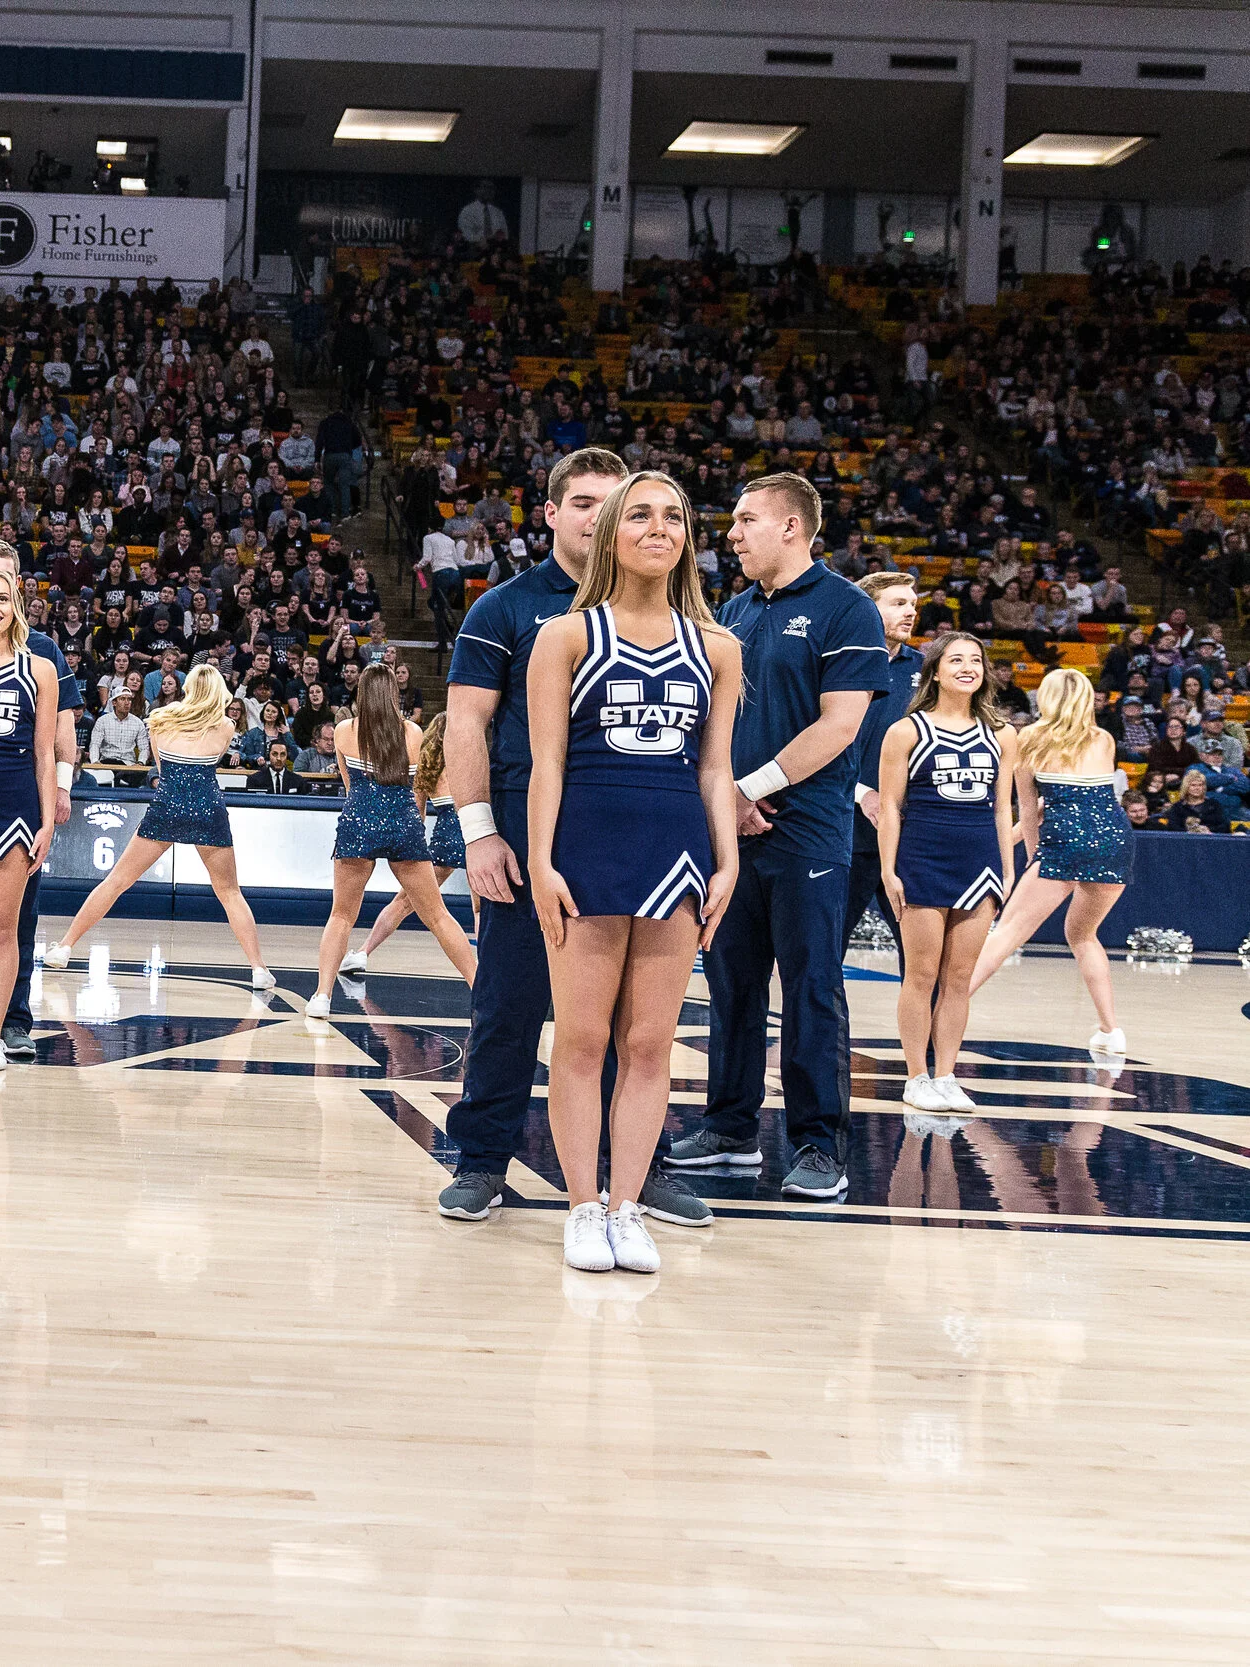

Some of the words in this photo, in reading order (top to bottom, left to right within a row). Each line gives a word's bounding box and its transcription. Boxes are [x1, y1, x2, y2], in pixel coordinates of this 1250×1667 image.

[603, 185, 621, 203] M
[979, 200, 994, 217] N
[47, 214, 154, 248] Fisher
[42, 248, 82, 262] Home
[84, 249, 159, 266] Furnishings
[600, 704, 699, 731] STATE
[605, 679, 698, 755] U
[931, 768, 995, 786] STATE
[934, 752, 993, 801] U
[83, 803, 128, 819] NEVADA
[93, 836, 115, 871] 6
